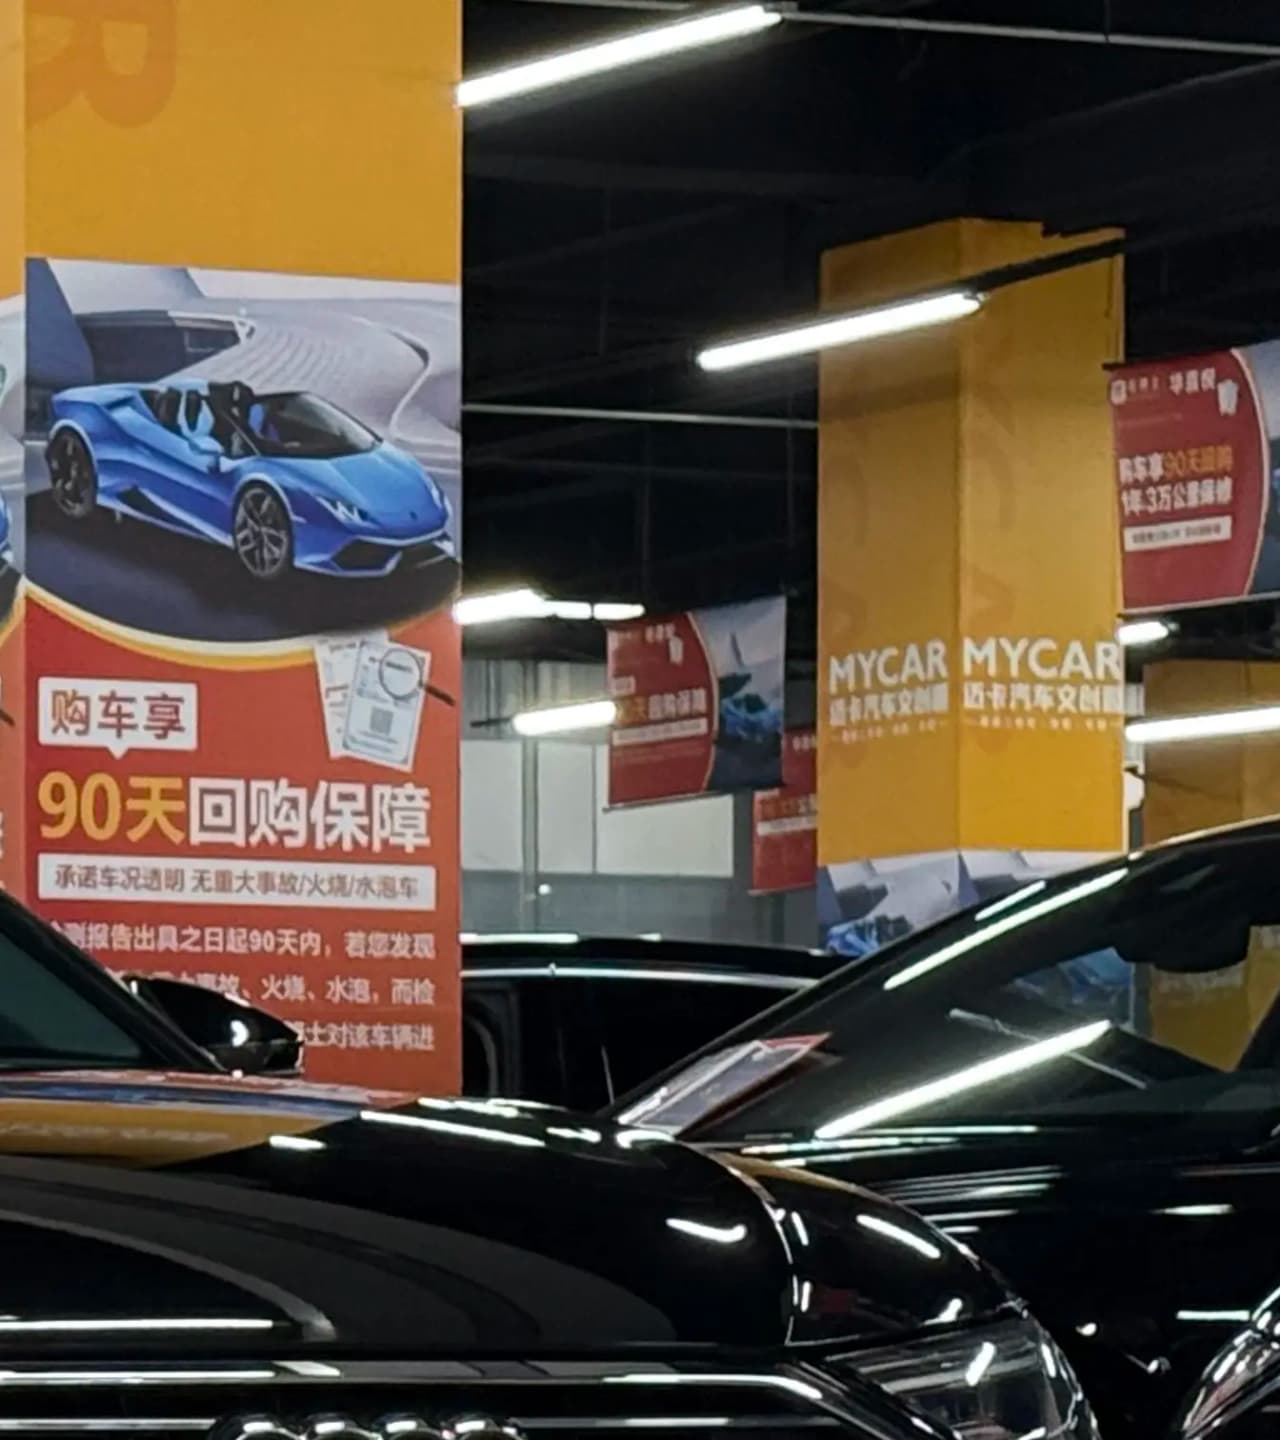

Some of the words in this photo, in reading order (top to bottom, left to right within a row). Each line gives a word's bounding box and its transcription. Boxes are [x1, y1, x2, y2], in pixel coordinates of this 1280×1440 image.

[828, 639, 948, 696] MYCAR
[962, 636, 1123, 681] MYCAR
[50, 690, 188, 740] 购车享
[37, 771, 433, 854] 90天回购保障
[54, 863, 186, 892] 承诺车况透明
